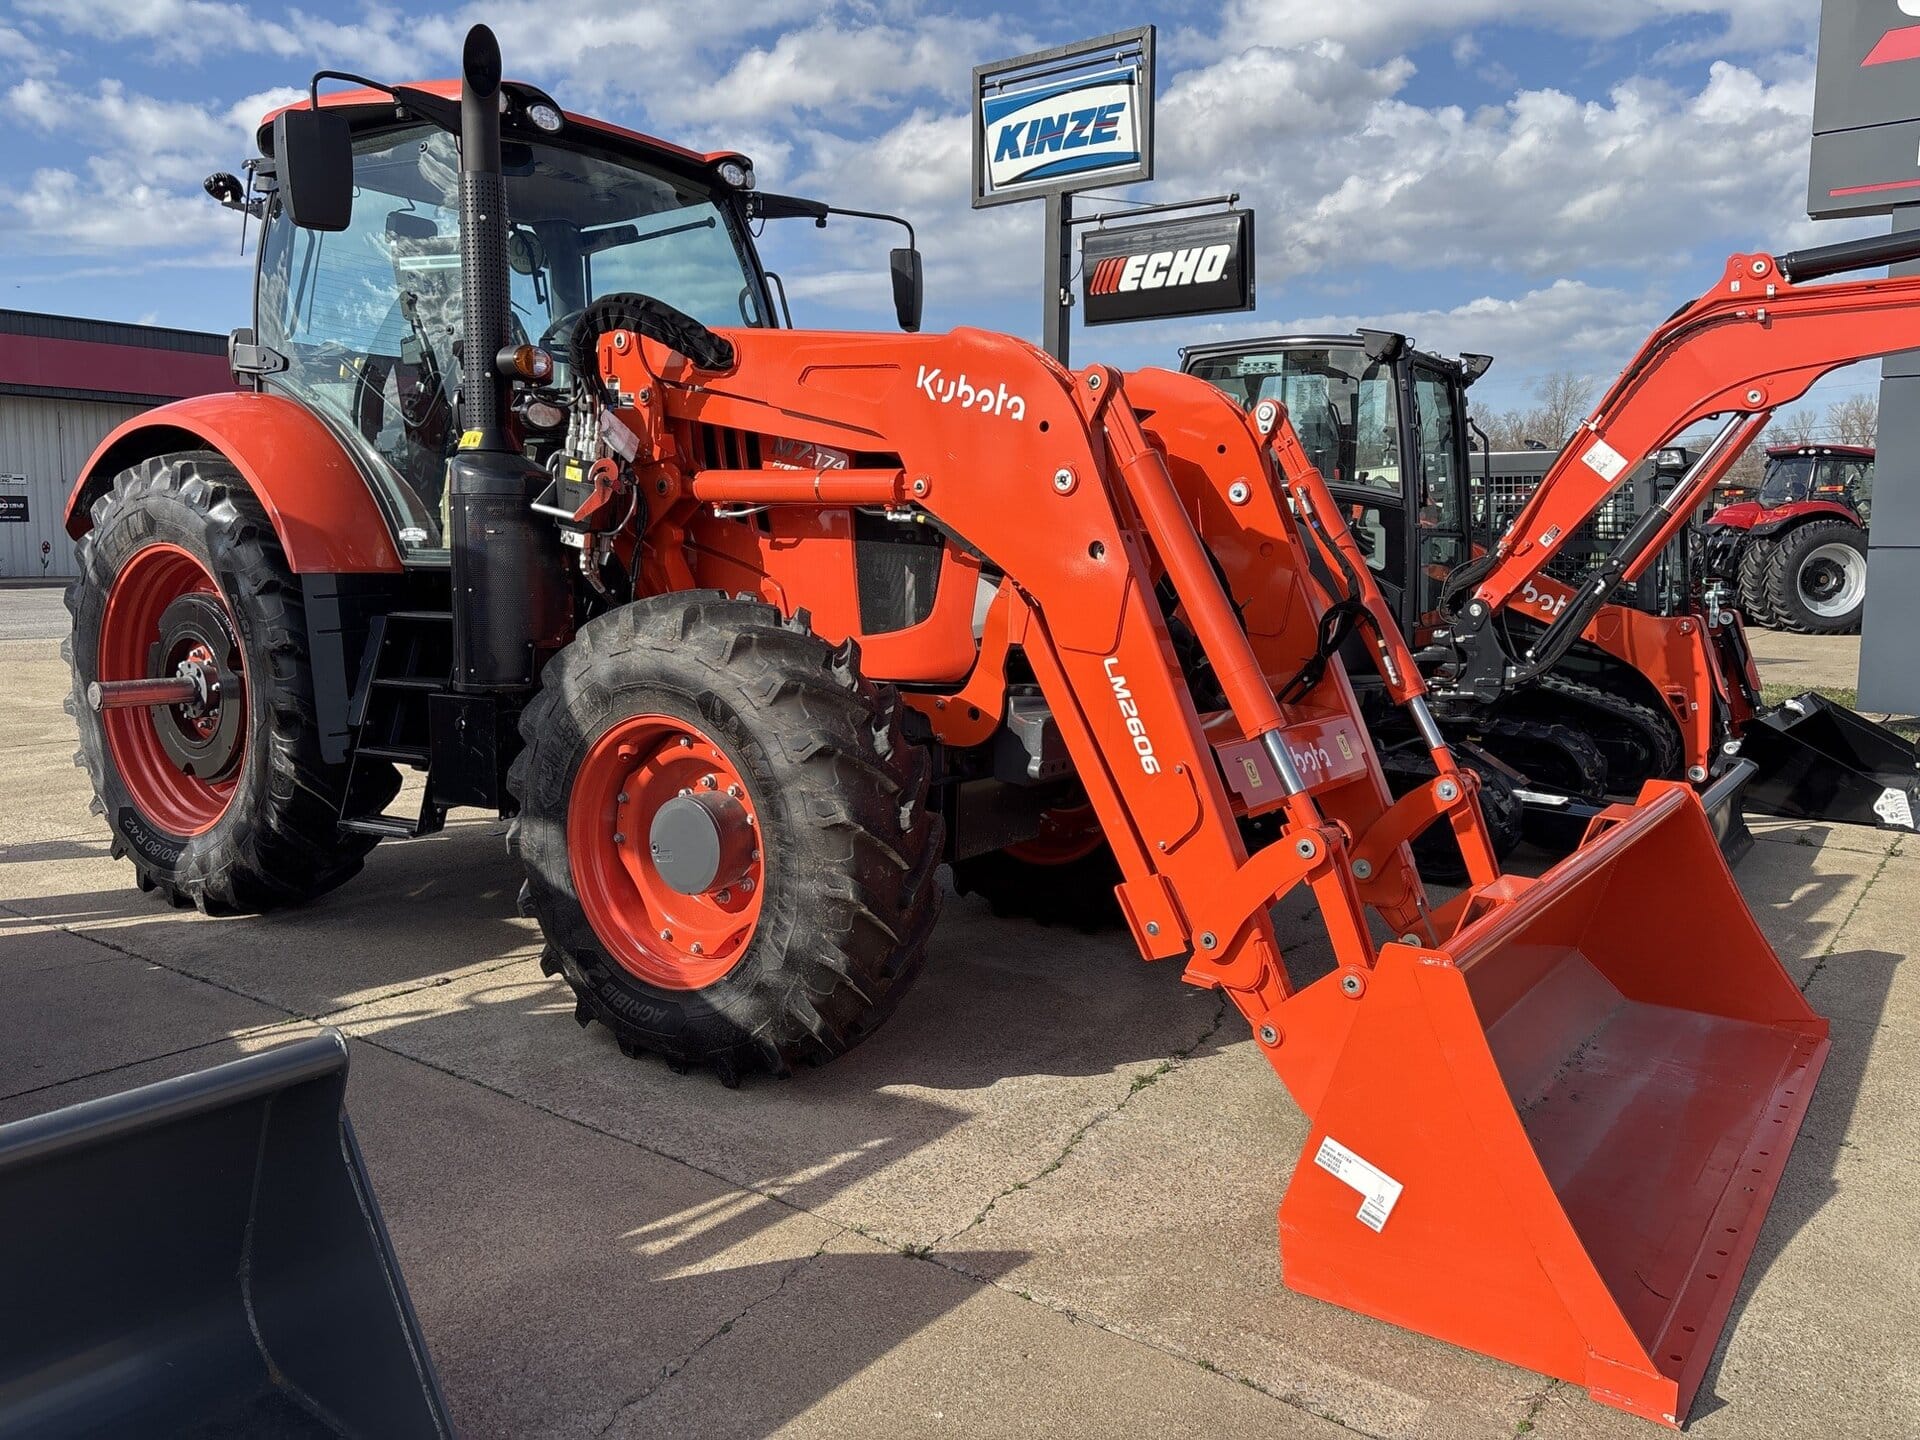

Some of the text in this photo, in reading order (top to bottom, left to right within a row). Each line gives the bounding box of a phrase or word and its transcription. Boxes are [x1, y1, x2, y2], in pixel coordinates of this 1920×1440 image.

[994, 102, 1126, 162] KINZE
[1117, 244, 1231, 292] ECHO
[916, 366, 1026, 421] Kubota
[1522, 580, 1567, 616] bot
[1103, 656, 1161, 775] LM2606
[1289, 741, 1332, 774] bota
